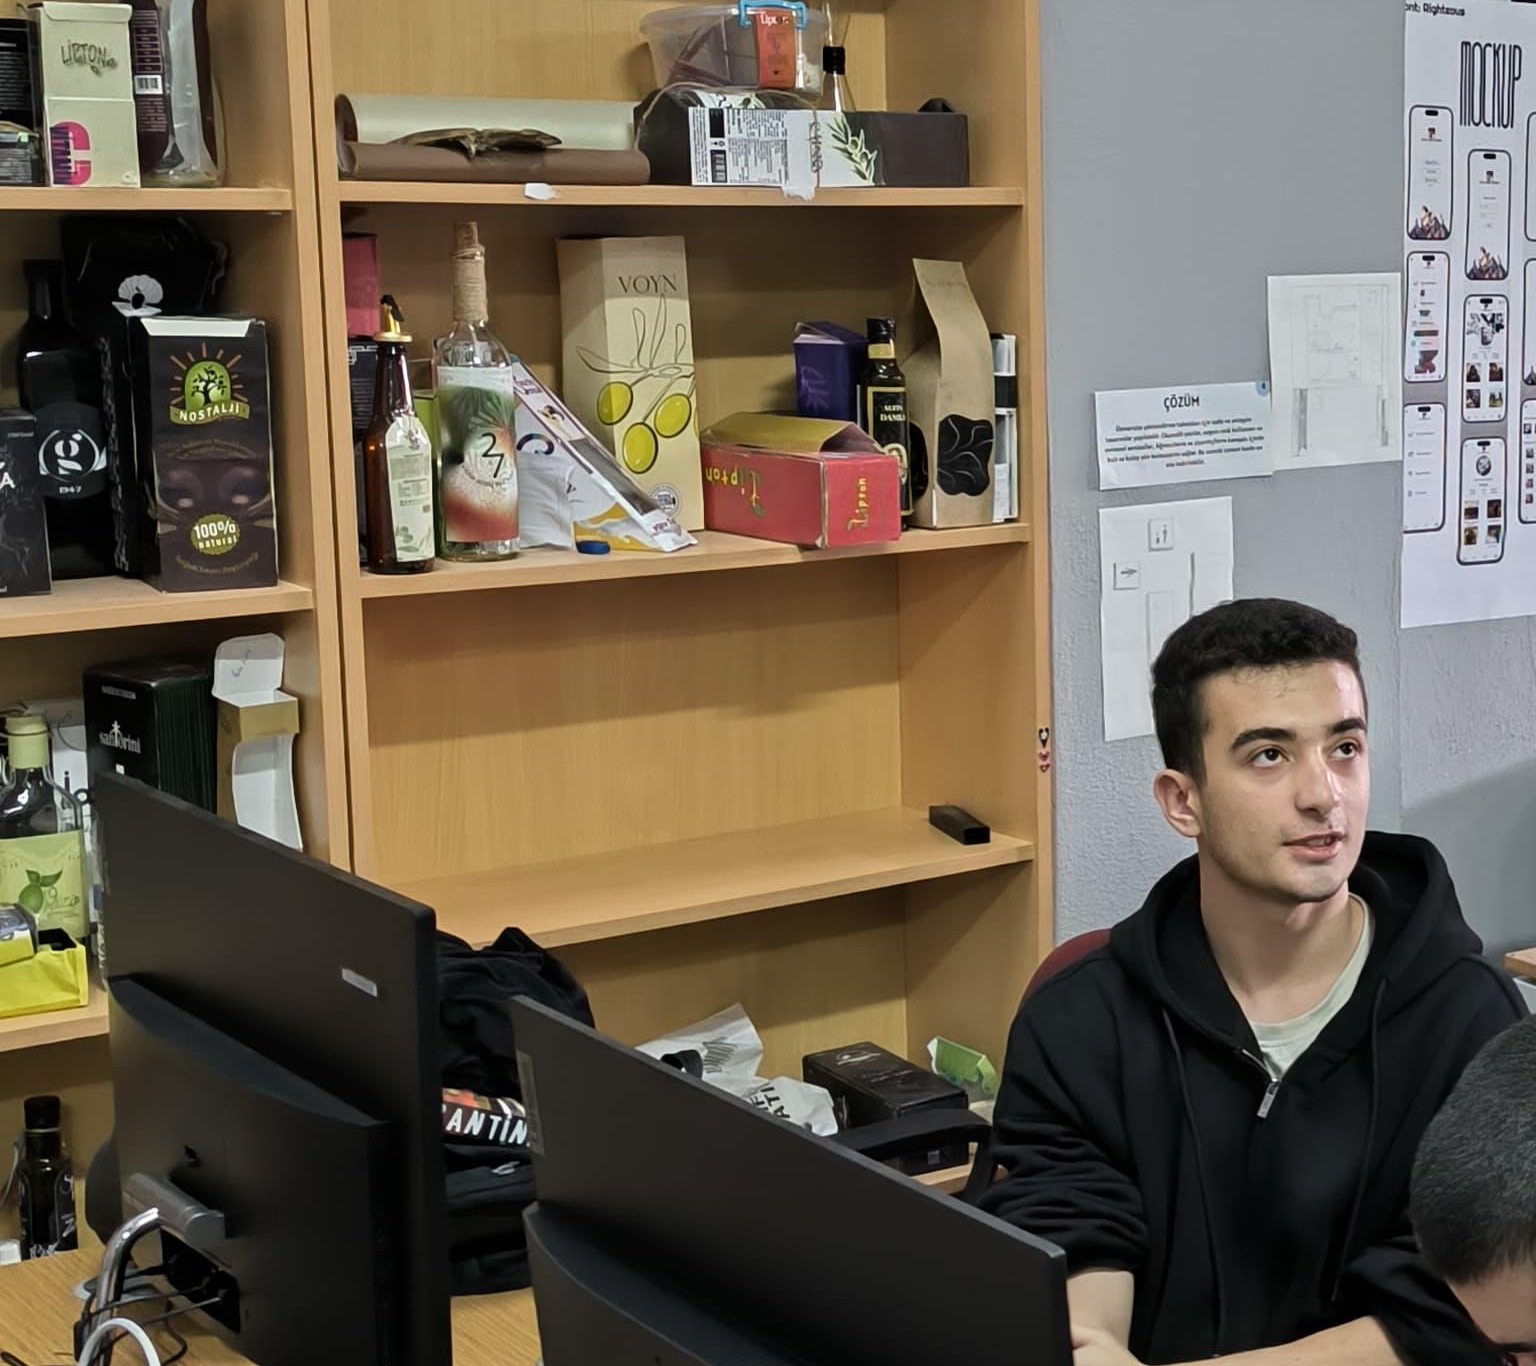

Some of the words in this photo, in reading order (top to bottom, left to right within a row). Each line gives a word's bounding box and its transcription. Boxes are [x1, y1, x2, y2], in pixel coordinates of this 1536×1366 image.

[1423, 3, 1466, 17] Righteous
[1459, 40, 1522, 129] MOCKUP
[618, 272, 678, 294] VOYN
[1163, 393, 1200, 412] ÇÖZÜM
[193, 517, 236, 539] 100%
[198, 535, 238, 549] natural
